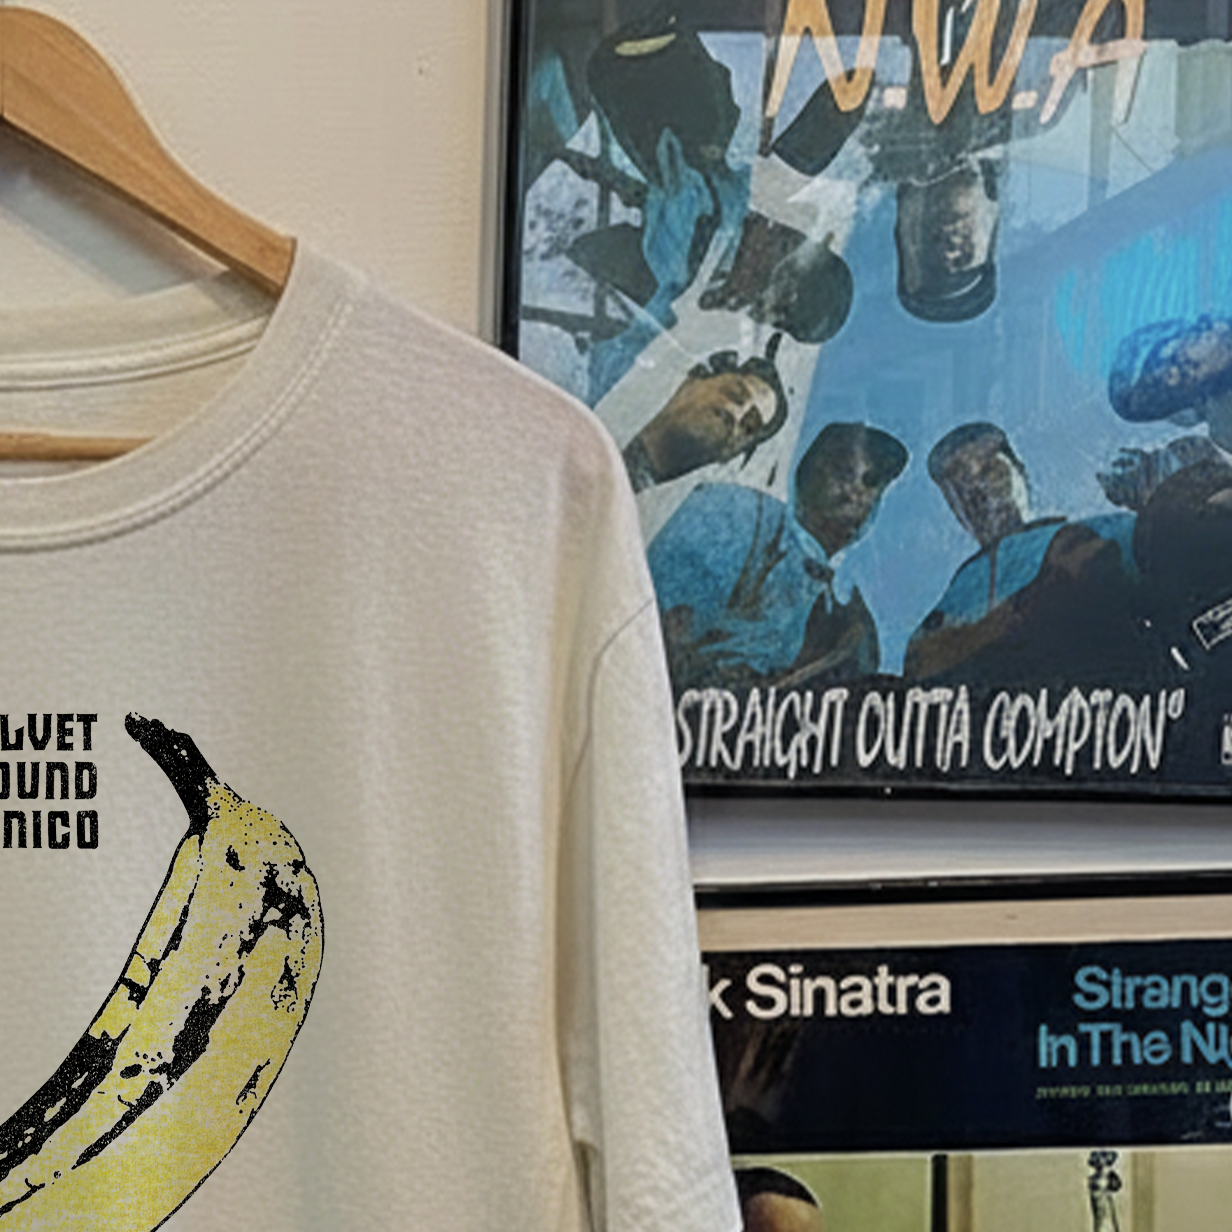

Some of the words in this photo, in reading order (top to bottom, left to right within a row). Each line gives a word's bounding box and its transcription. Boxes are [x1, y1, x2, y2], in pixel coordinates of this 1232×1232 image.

[676, 685, 848, 779] STRAIGHT
[856, 685, 969, 773] OUTTA
[2, 809, 100, 850] NICO
[744, 962, 952, 1020] Sinatra
[1072, 964, 1232, 1018] Strang
[1038, 1022, 1079, 1069] In
[1077, 1021, 1172, 1067] The
